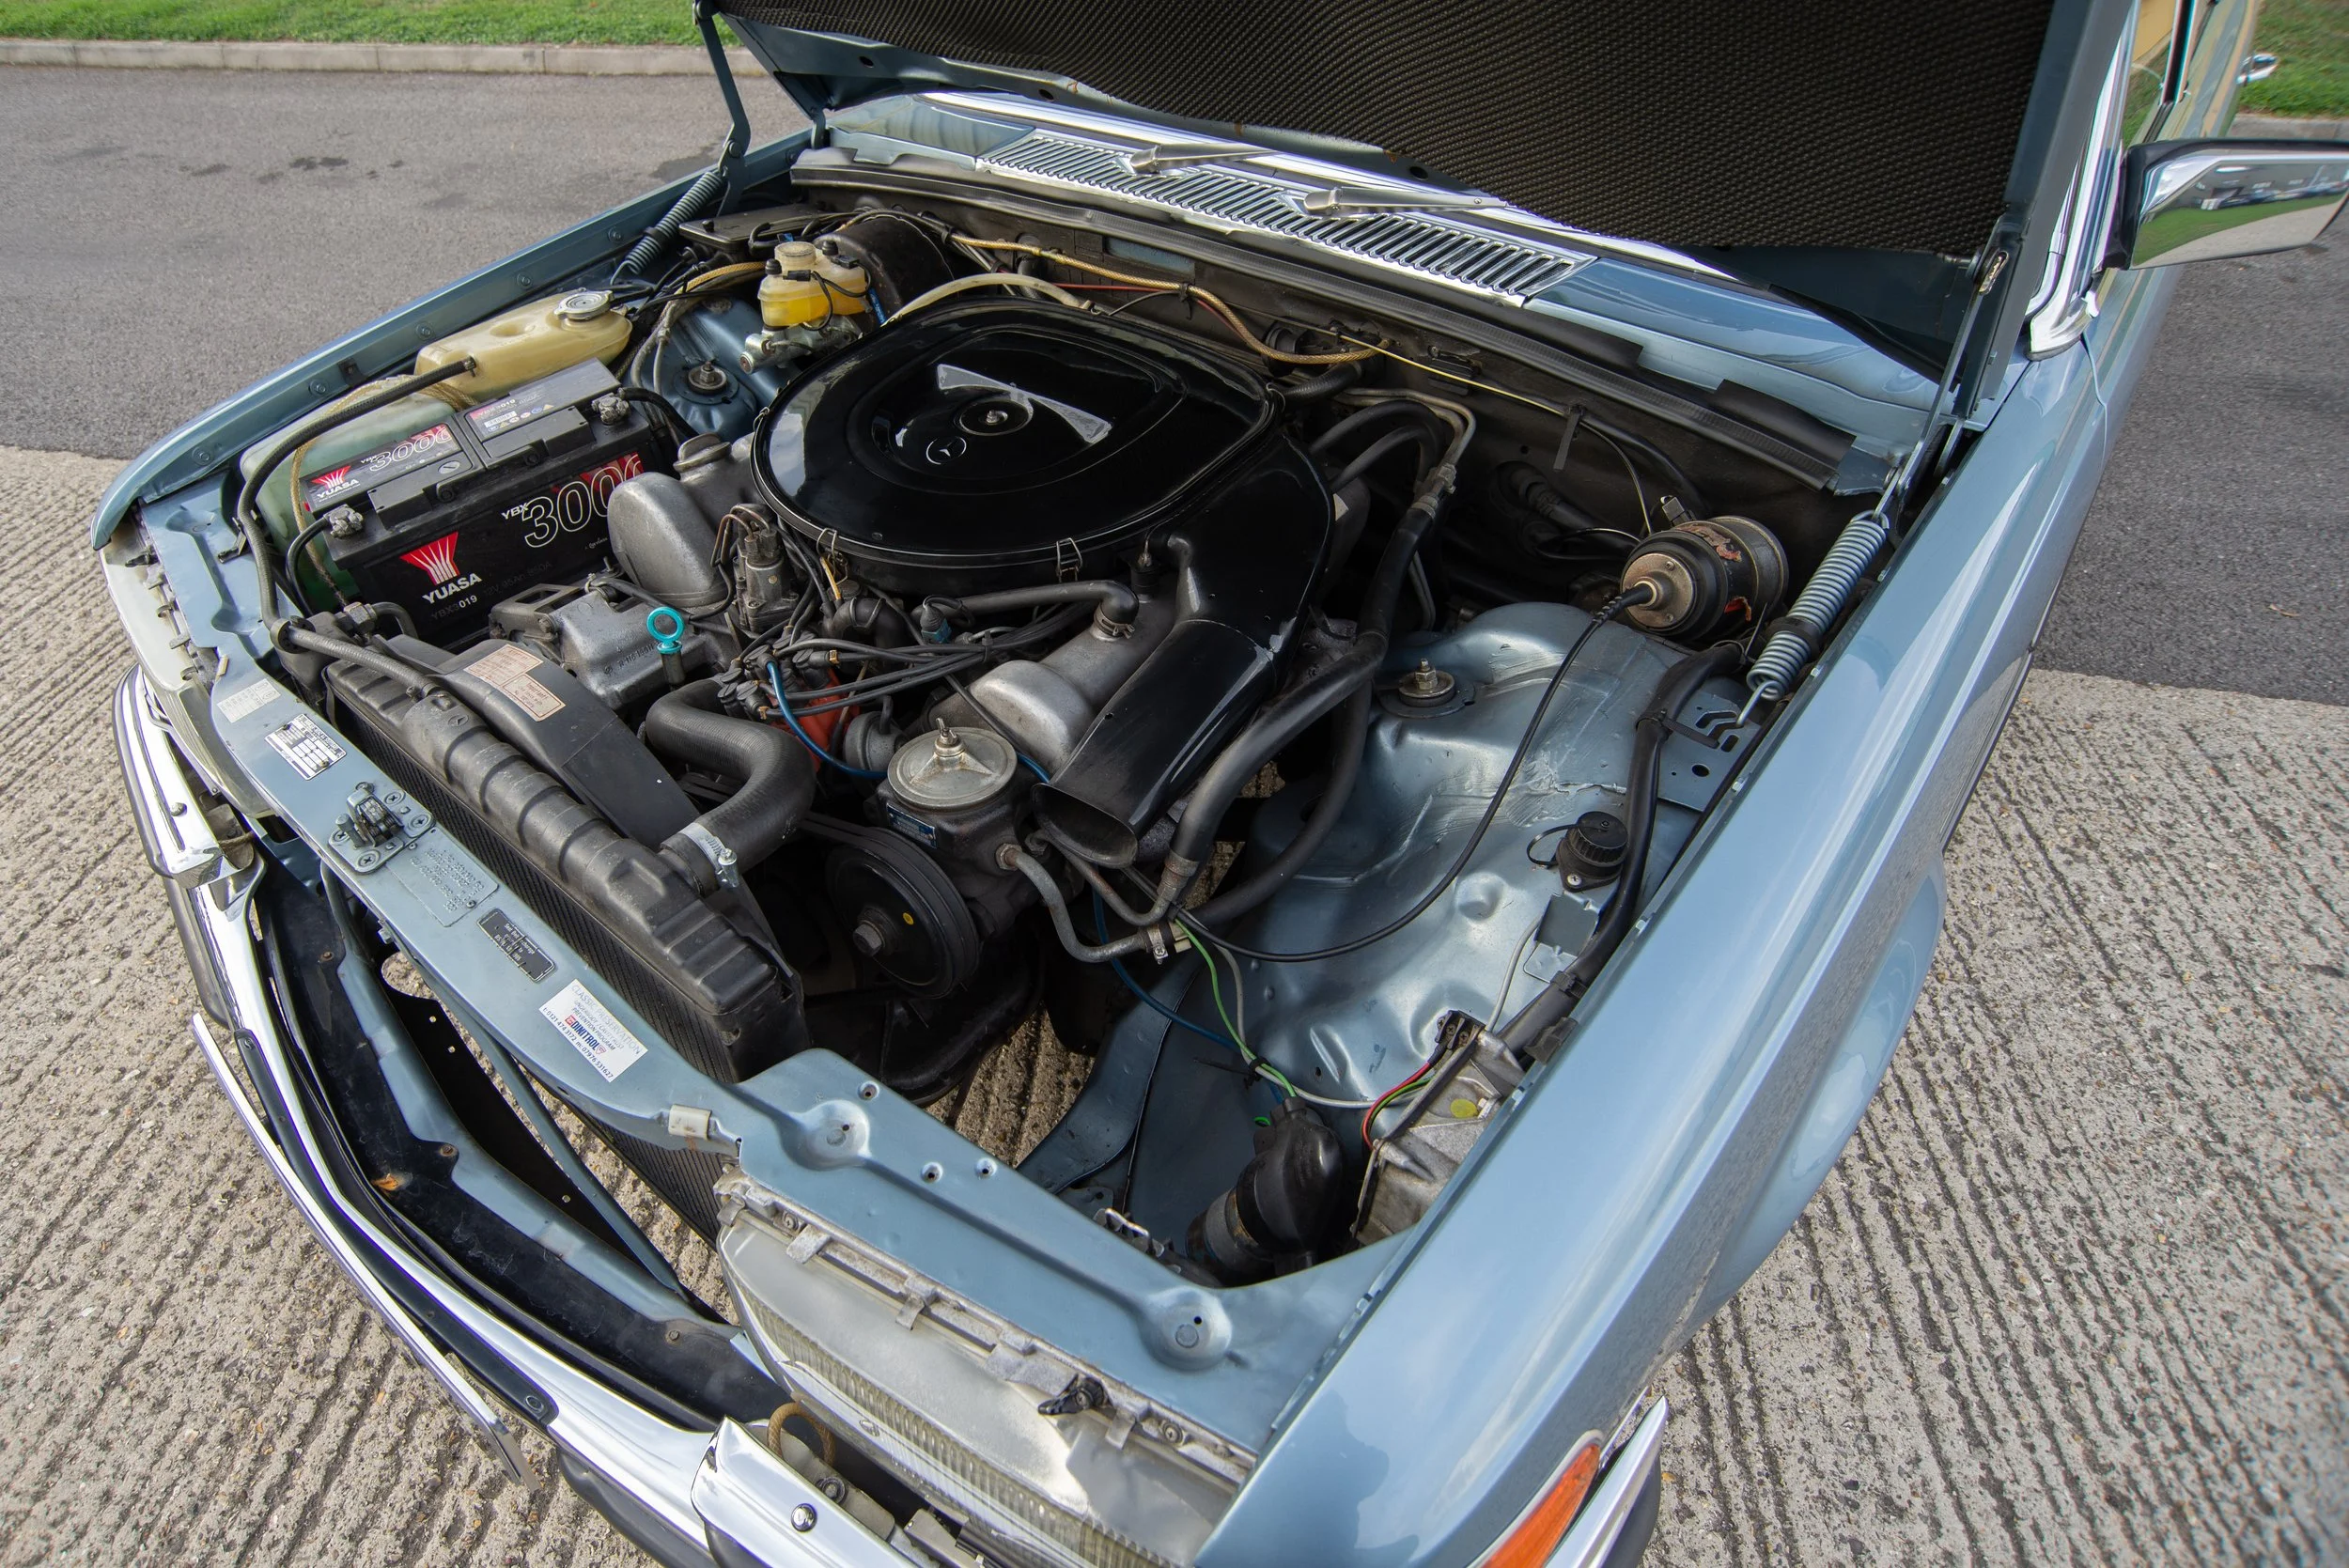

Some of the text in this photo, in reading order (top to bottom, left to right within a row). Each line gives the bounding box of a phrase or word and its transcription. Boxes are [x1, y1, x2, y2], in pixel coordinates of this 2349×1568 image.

[317, 479, 359, 498] YUASA
[501, 502, 529, 520] YBX
[422, 573, 482, 604] YUASA
[431, 595, 478, 620] YBX3019
[570, 984, 642, 1054] CLASSIC PRESERVATION
[571, 1007, 615, 1051] PREVENTION PROGRAM
[569, 1020, 600, 1050] DINITROL
[582, 1047, 597, 1063] 07976
[594, 1061, 614, 1079] 531627
